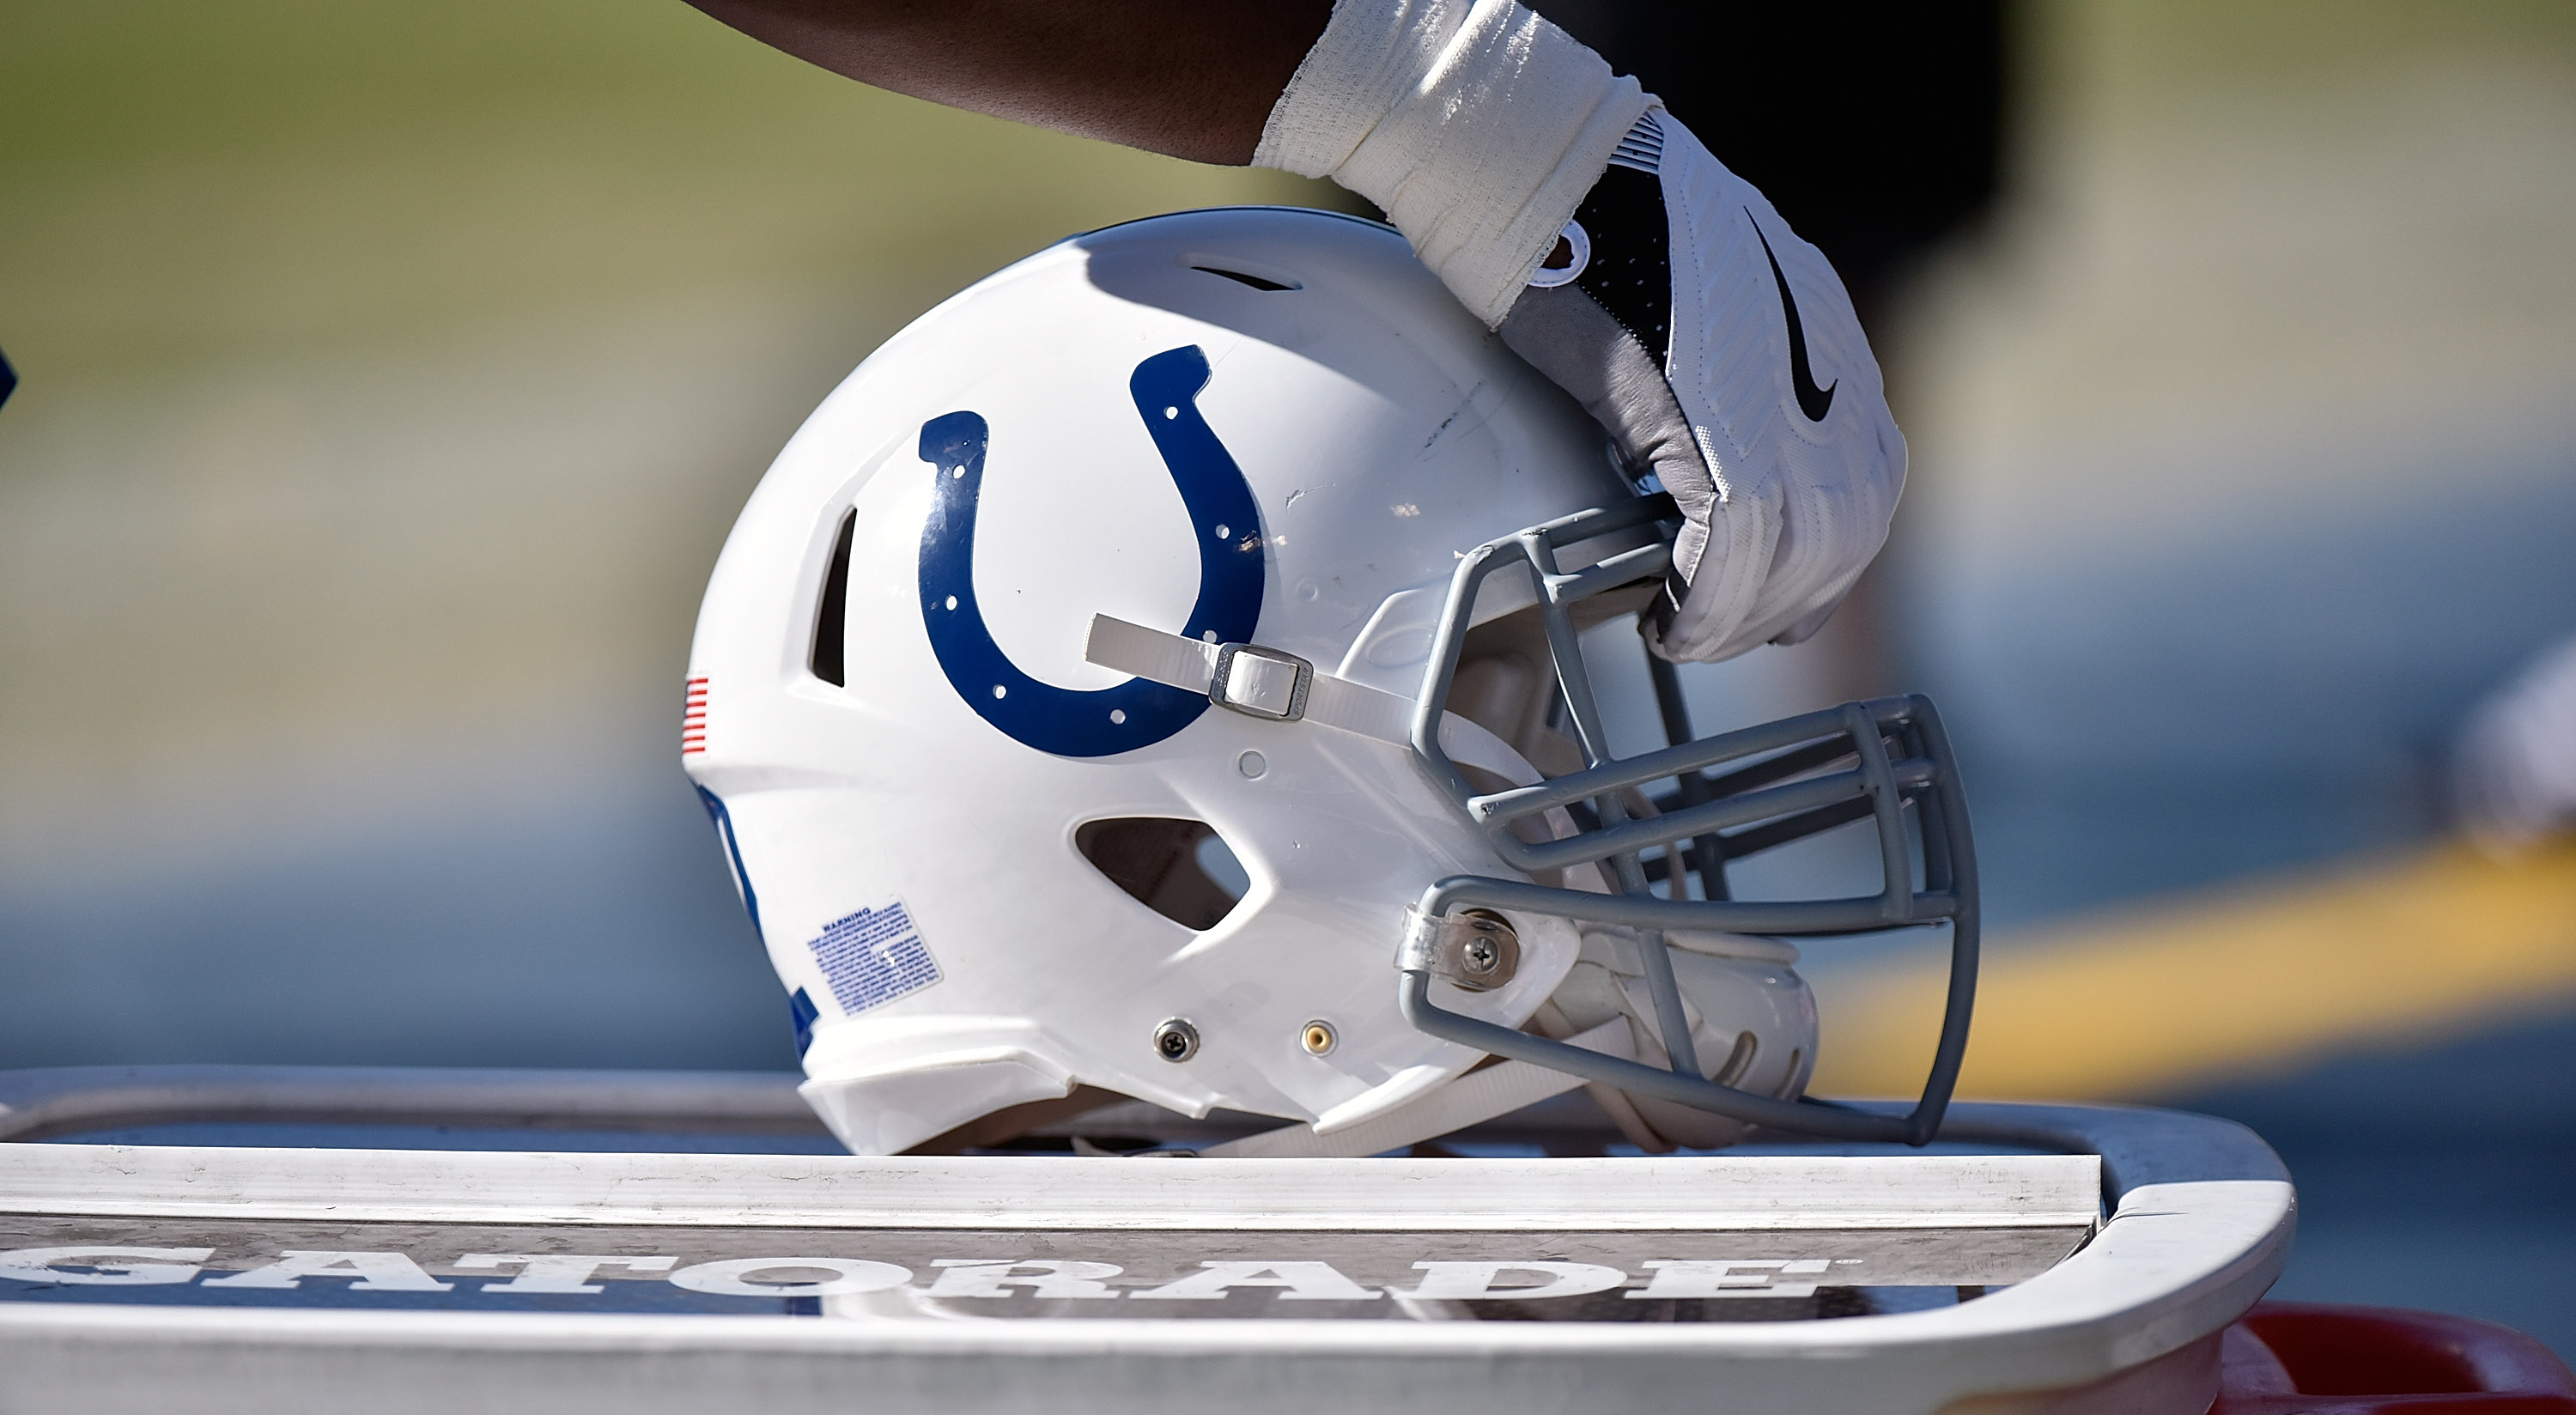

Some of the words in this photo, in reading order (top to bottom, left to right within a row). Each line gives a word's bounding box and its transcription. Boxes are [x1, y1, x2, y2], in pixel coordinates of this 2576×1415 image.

[1294, 667, 1309, 716] SPORTSTAR
[823, 907, 871, 932] WARNING
[0, 1246, 1832, 1298] GATORADE
